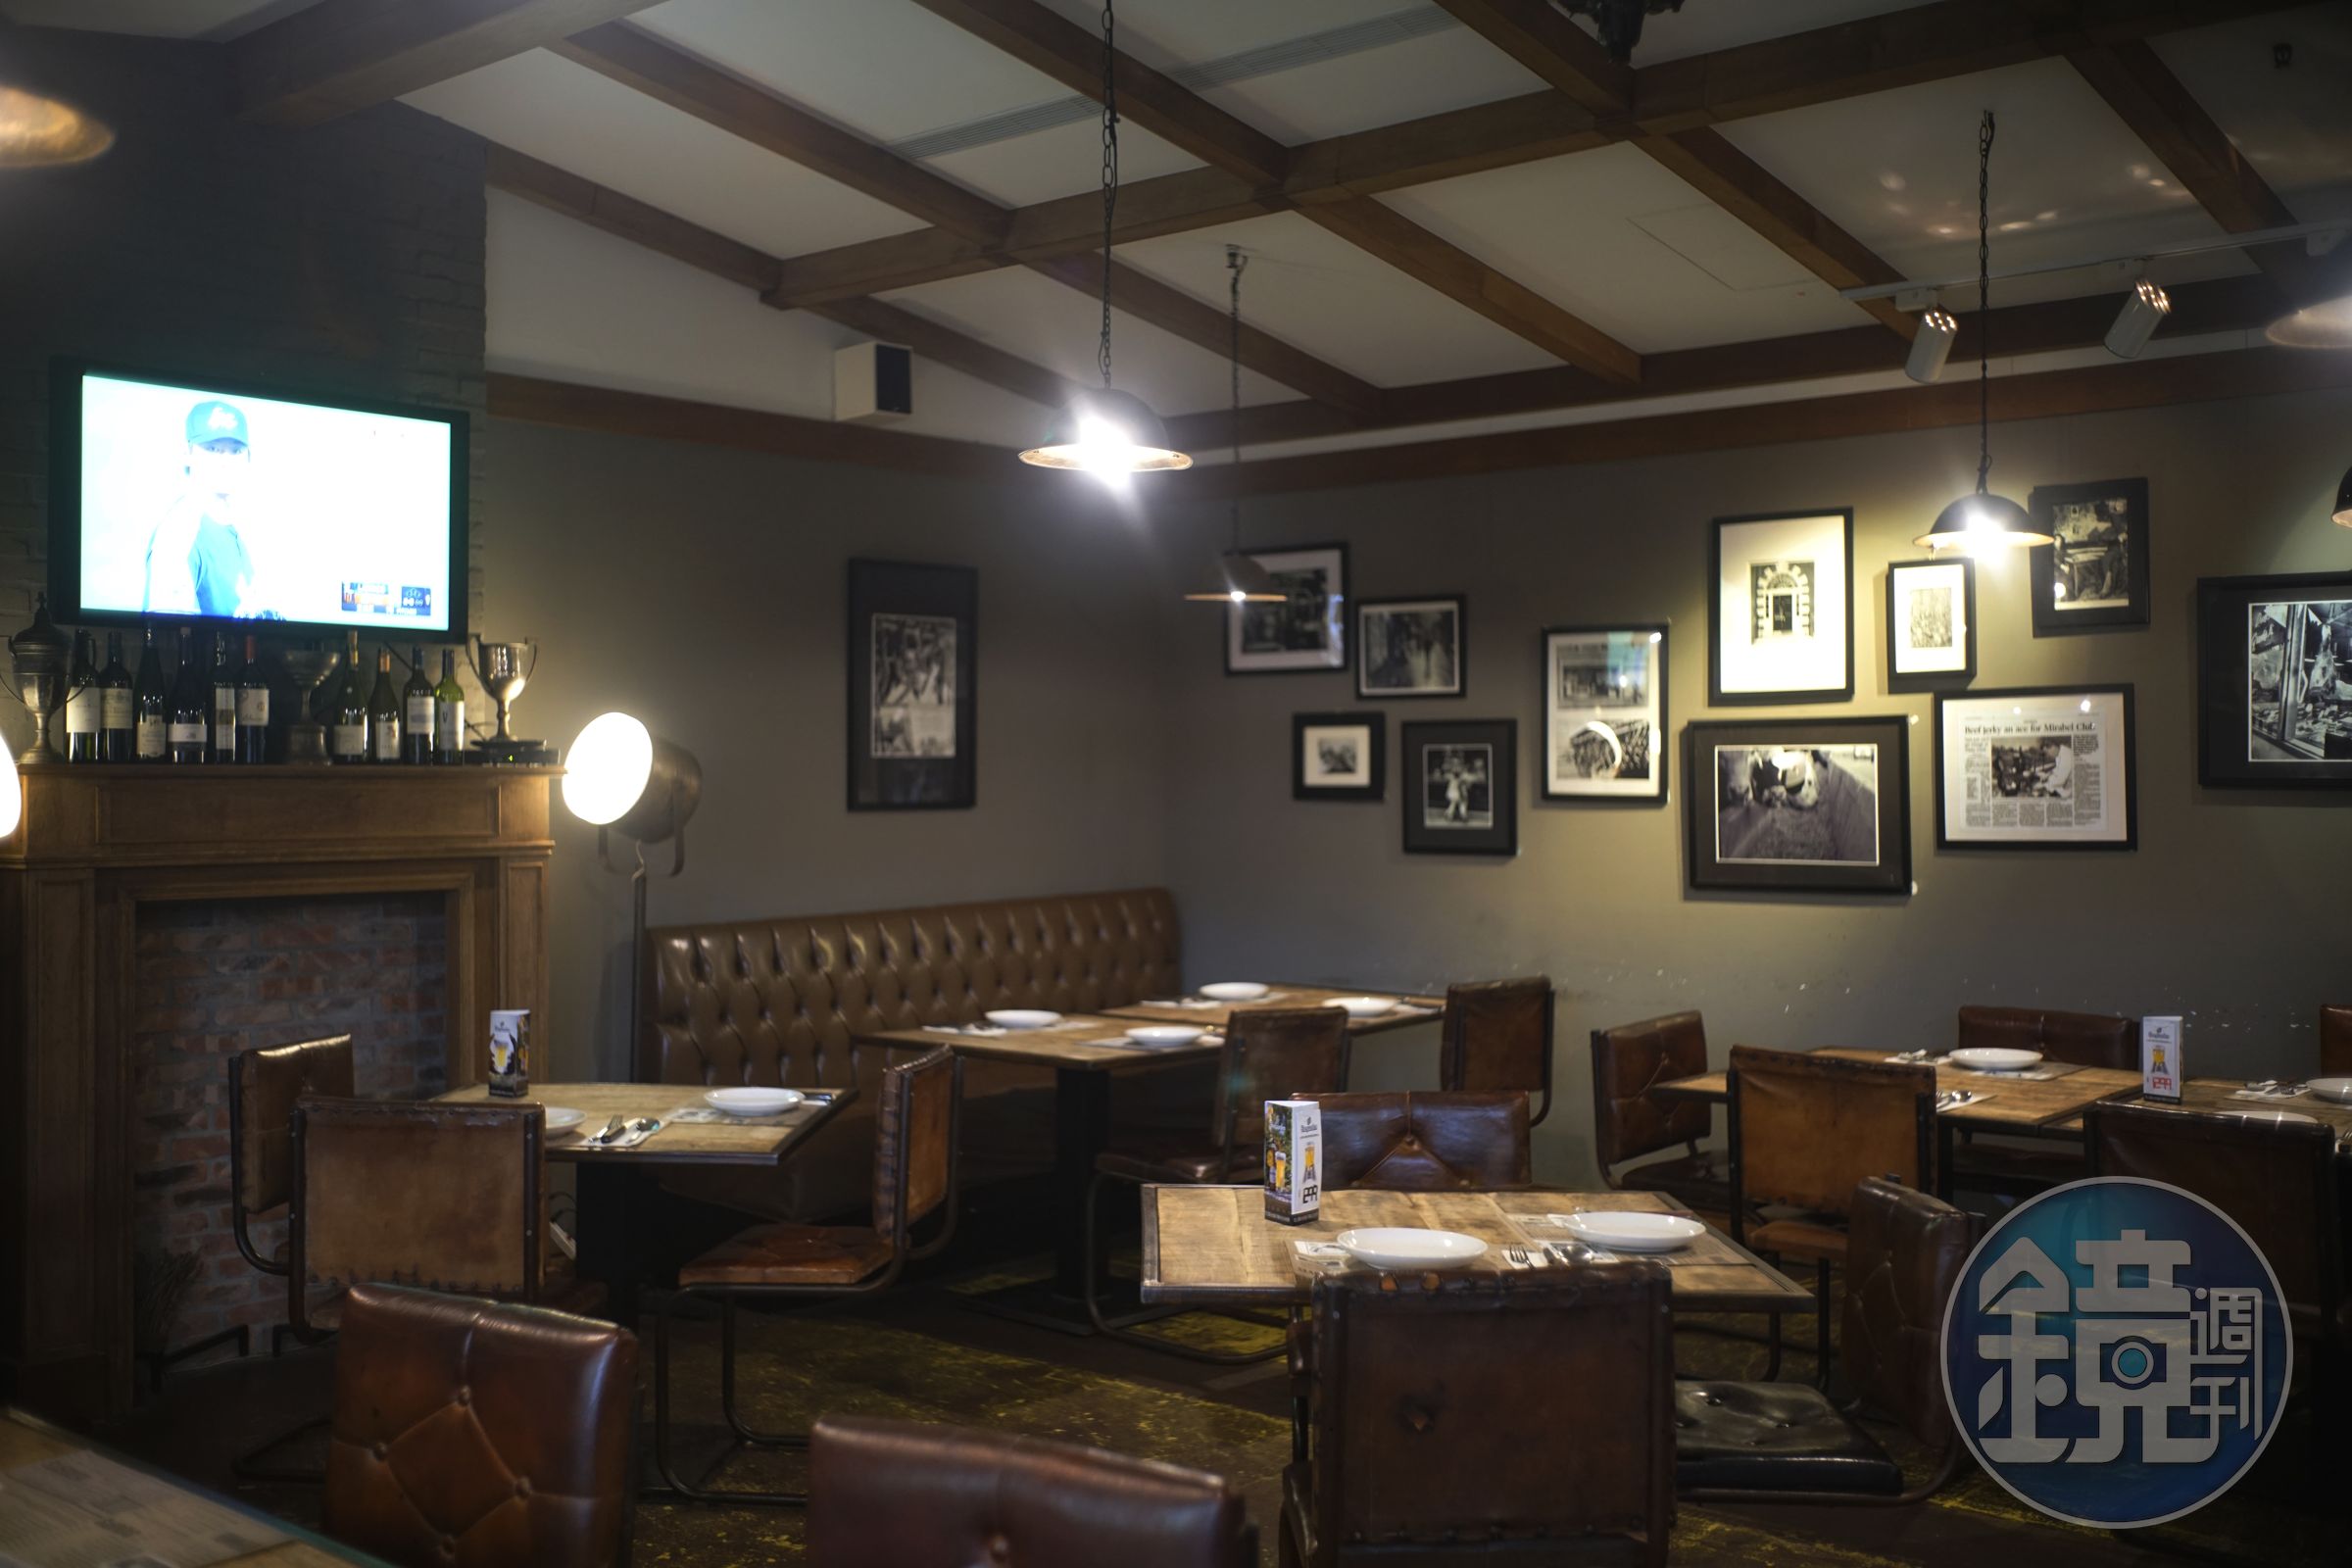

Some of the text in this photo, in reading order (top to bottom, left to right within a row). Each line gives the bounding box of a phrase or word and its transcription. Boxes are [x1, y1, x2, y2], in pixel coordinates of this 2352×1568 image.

[1965, 724, 1981, 734] Beef
[1983, 724, 2000, 736] jerky
[2015, 724, 2028, 733] ace
[2031, 722, 2040, 732] for
[2043, 721, 2074, 732] Mirabel
